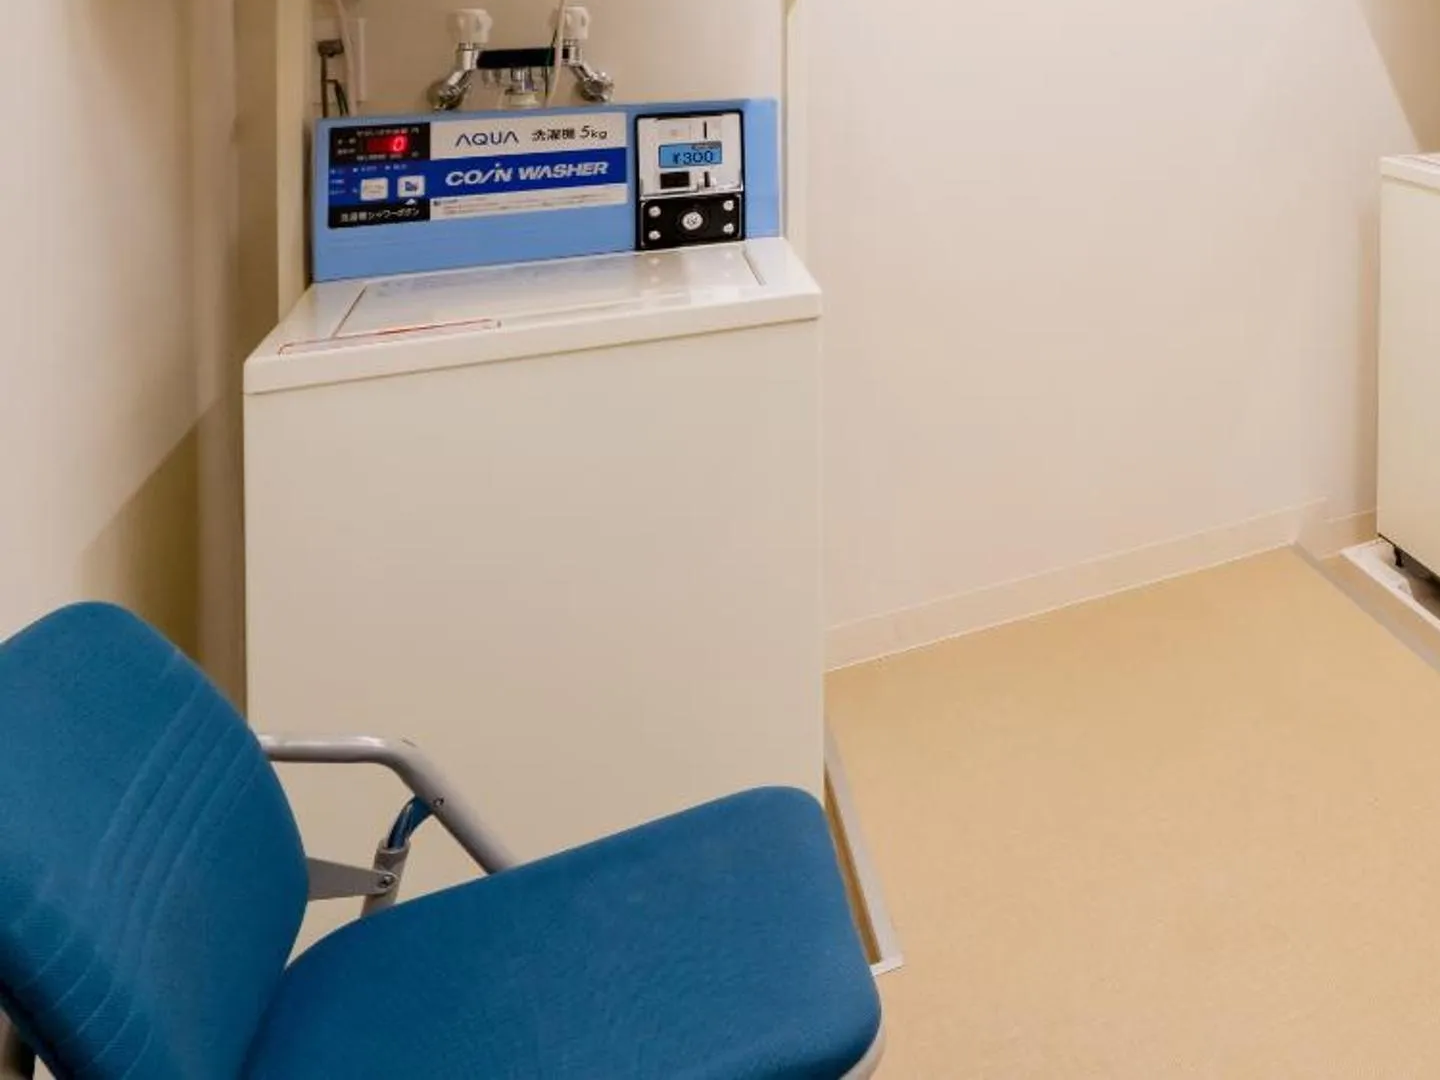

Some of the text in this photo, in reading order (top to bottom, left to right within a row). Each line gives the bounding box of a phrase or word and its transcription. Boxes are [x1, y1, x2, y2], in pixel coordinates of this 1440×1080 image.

[393, 135, 408, 152] 0
[455, 130, 519, 148] AQUA
[579, 125, 608, 141] 5kg
[445, 161, 609, 187] COIN WASHER
